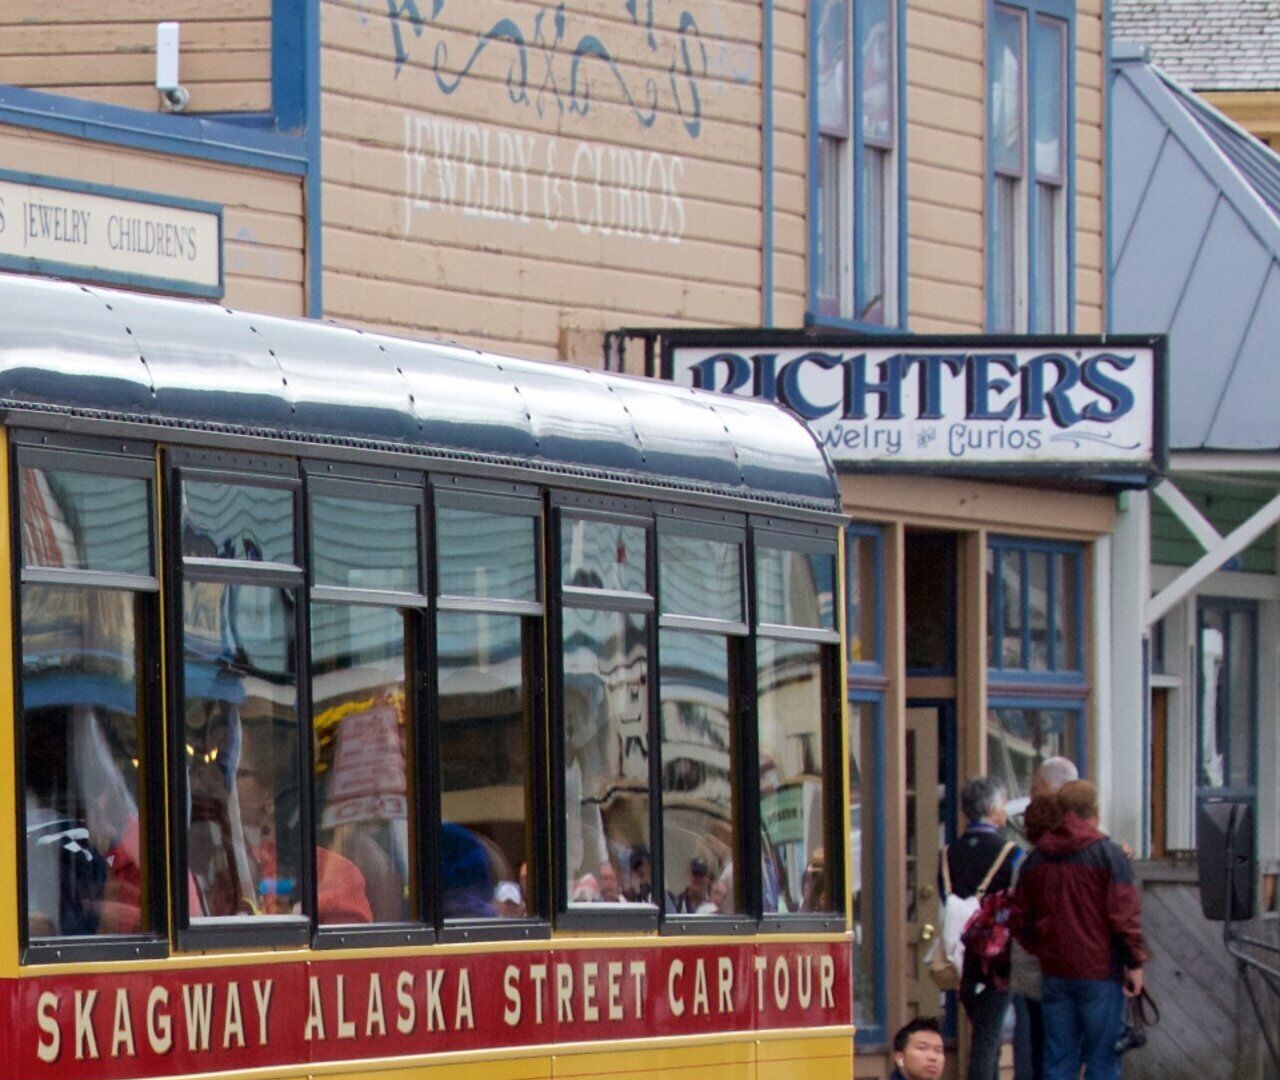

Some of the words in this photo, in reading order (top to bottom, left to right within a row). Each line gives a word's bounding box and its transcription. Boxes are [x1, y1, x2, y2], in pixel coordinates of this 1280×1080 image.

[403, 115, 535, 240] JEWELRY
[543, 140, 561, 231] &
[571, 143, 685, 244] CURIOS
[23, 202, 91, 248] JEWELRY
[107, 215, 197, 261] CHILDREN'S
[948, 422, 1042, 457] Curios
[37, 980, 273, 1063] SKAGWAY
[304, 967, 475, 1040] ALASKA
[504, 960, 646, 1026] STREET
[668, 957, 734, 1016] CAR
[754, 955, 835, 1011] TOUR
